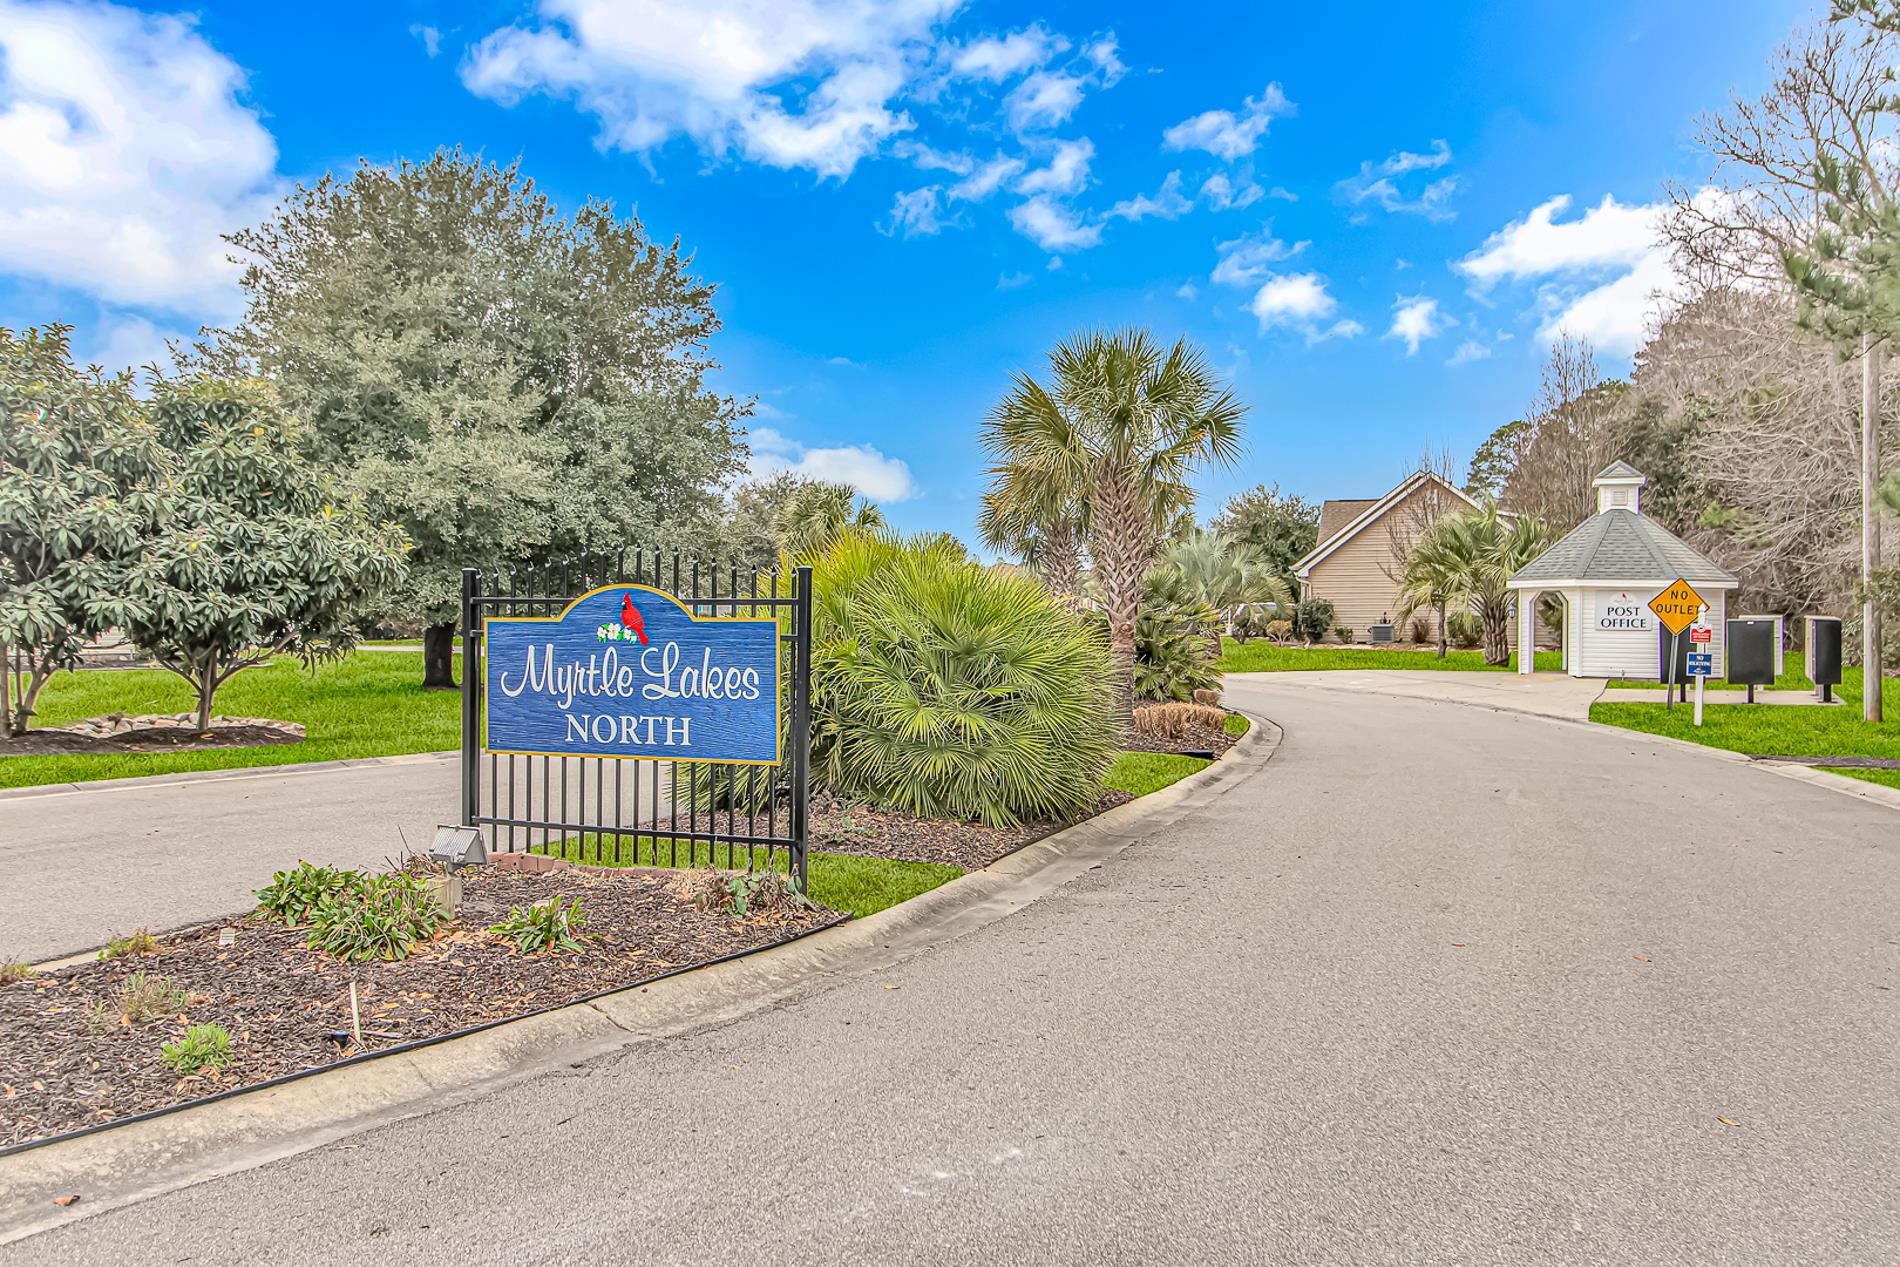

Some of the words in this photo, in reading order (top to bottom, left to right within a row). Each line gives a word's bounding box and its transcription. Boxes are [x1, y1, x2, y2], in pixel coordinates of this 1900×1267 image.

[1671, 590, 1688, 600] NO
[1607, 606, 1640, 616] POST
[1600, 618, 1646, 628] OFFICE
[502, 643, 633, 709] Myrtle
[640, 641, 760, 700] Lakes
[564, 714, 692, 746] NORTH
